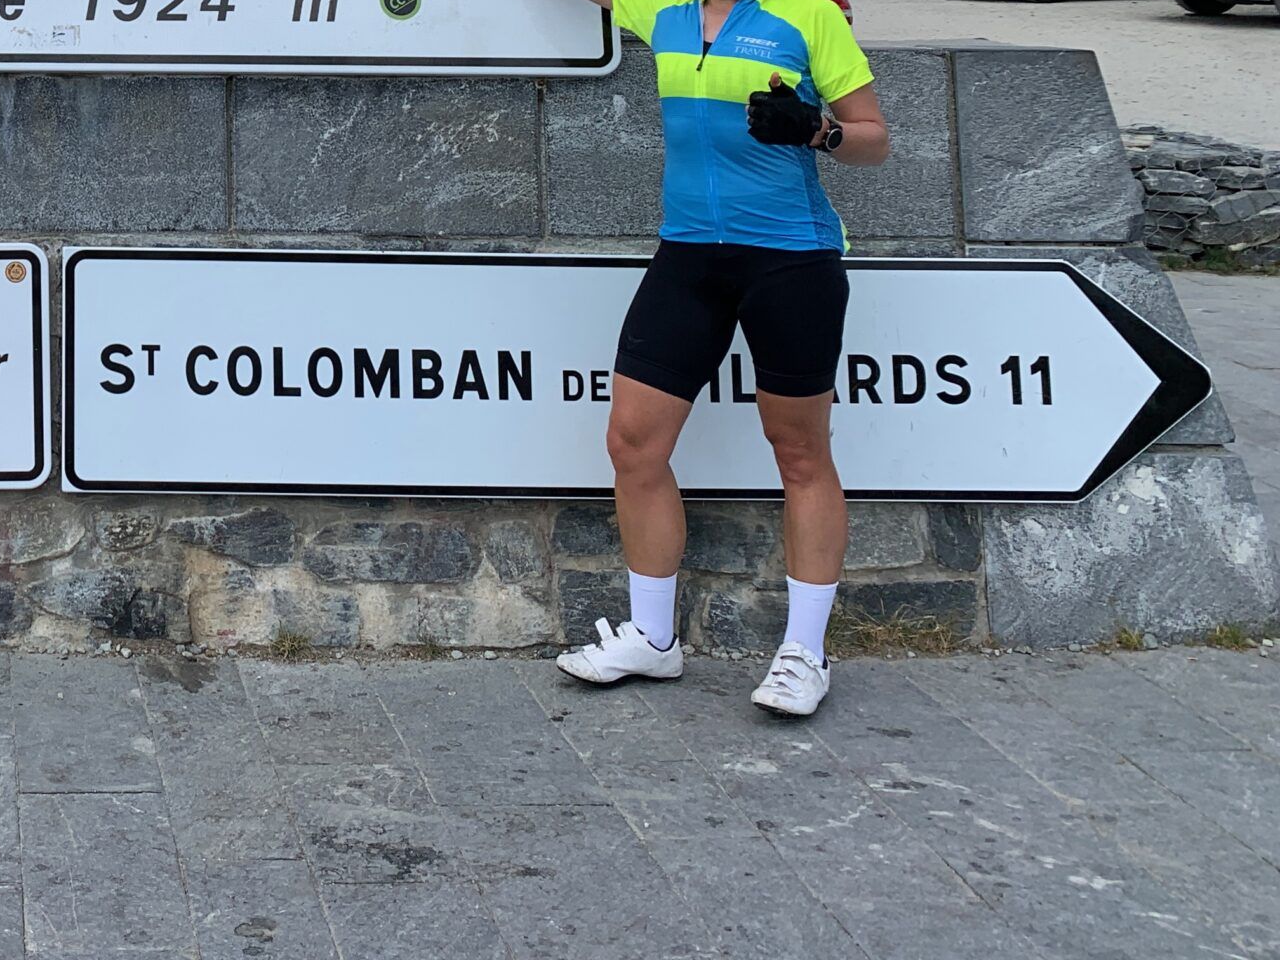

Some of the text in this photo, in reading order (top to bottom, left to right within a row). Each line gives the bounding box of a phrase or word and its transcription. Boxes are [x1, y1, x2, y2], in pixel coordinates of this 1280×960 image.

[736, 35, 780, 48] TREK
[735, 46, 773, 60] TRAVEL
[186, 346, 532, 400] COLOMBAN
[563, 370, 610, 401] DE
[1001, 356, 1052, 405] 11
